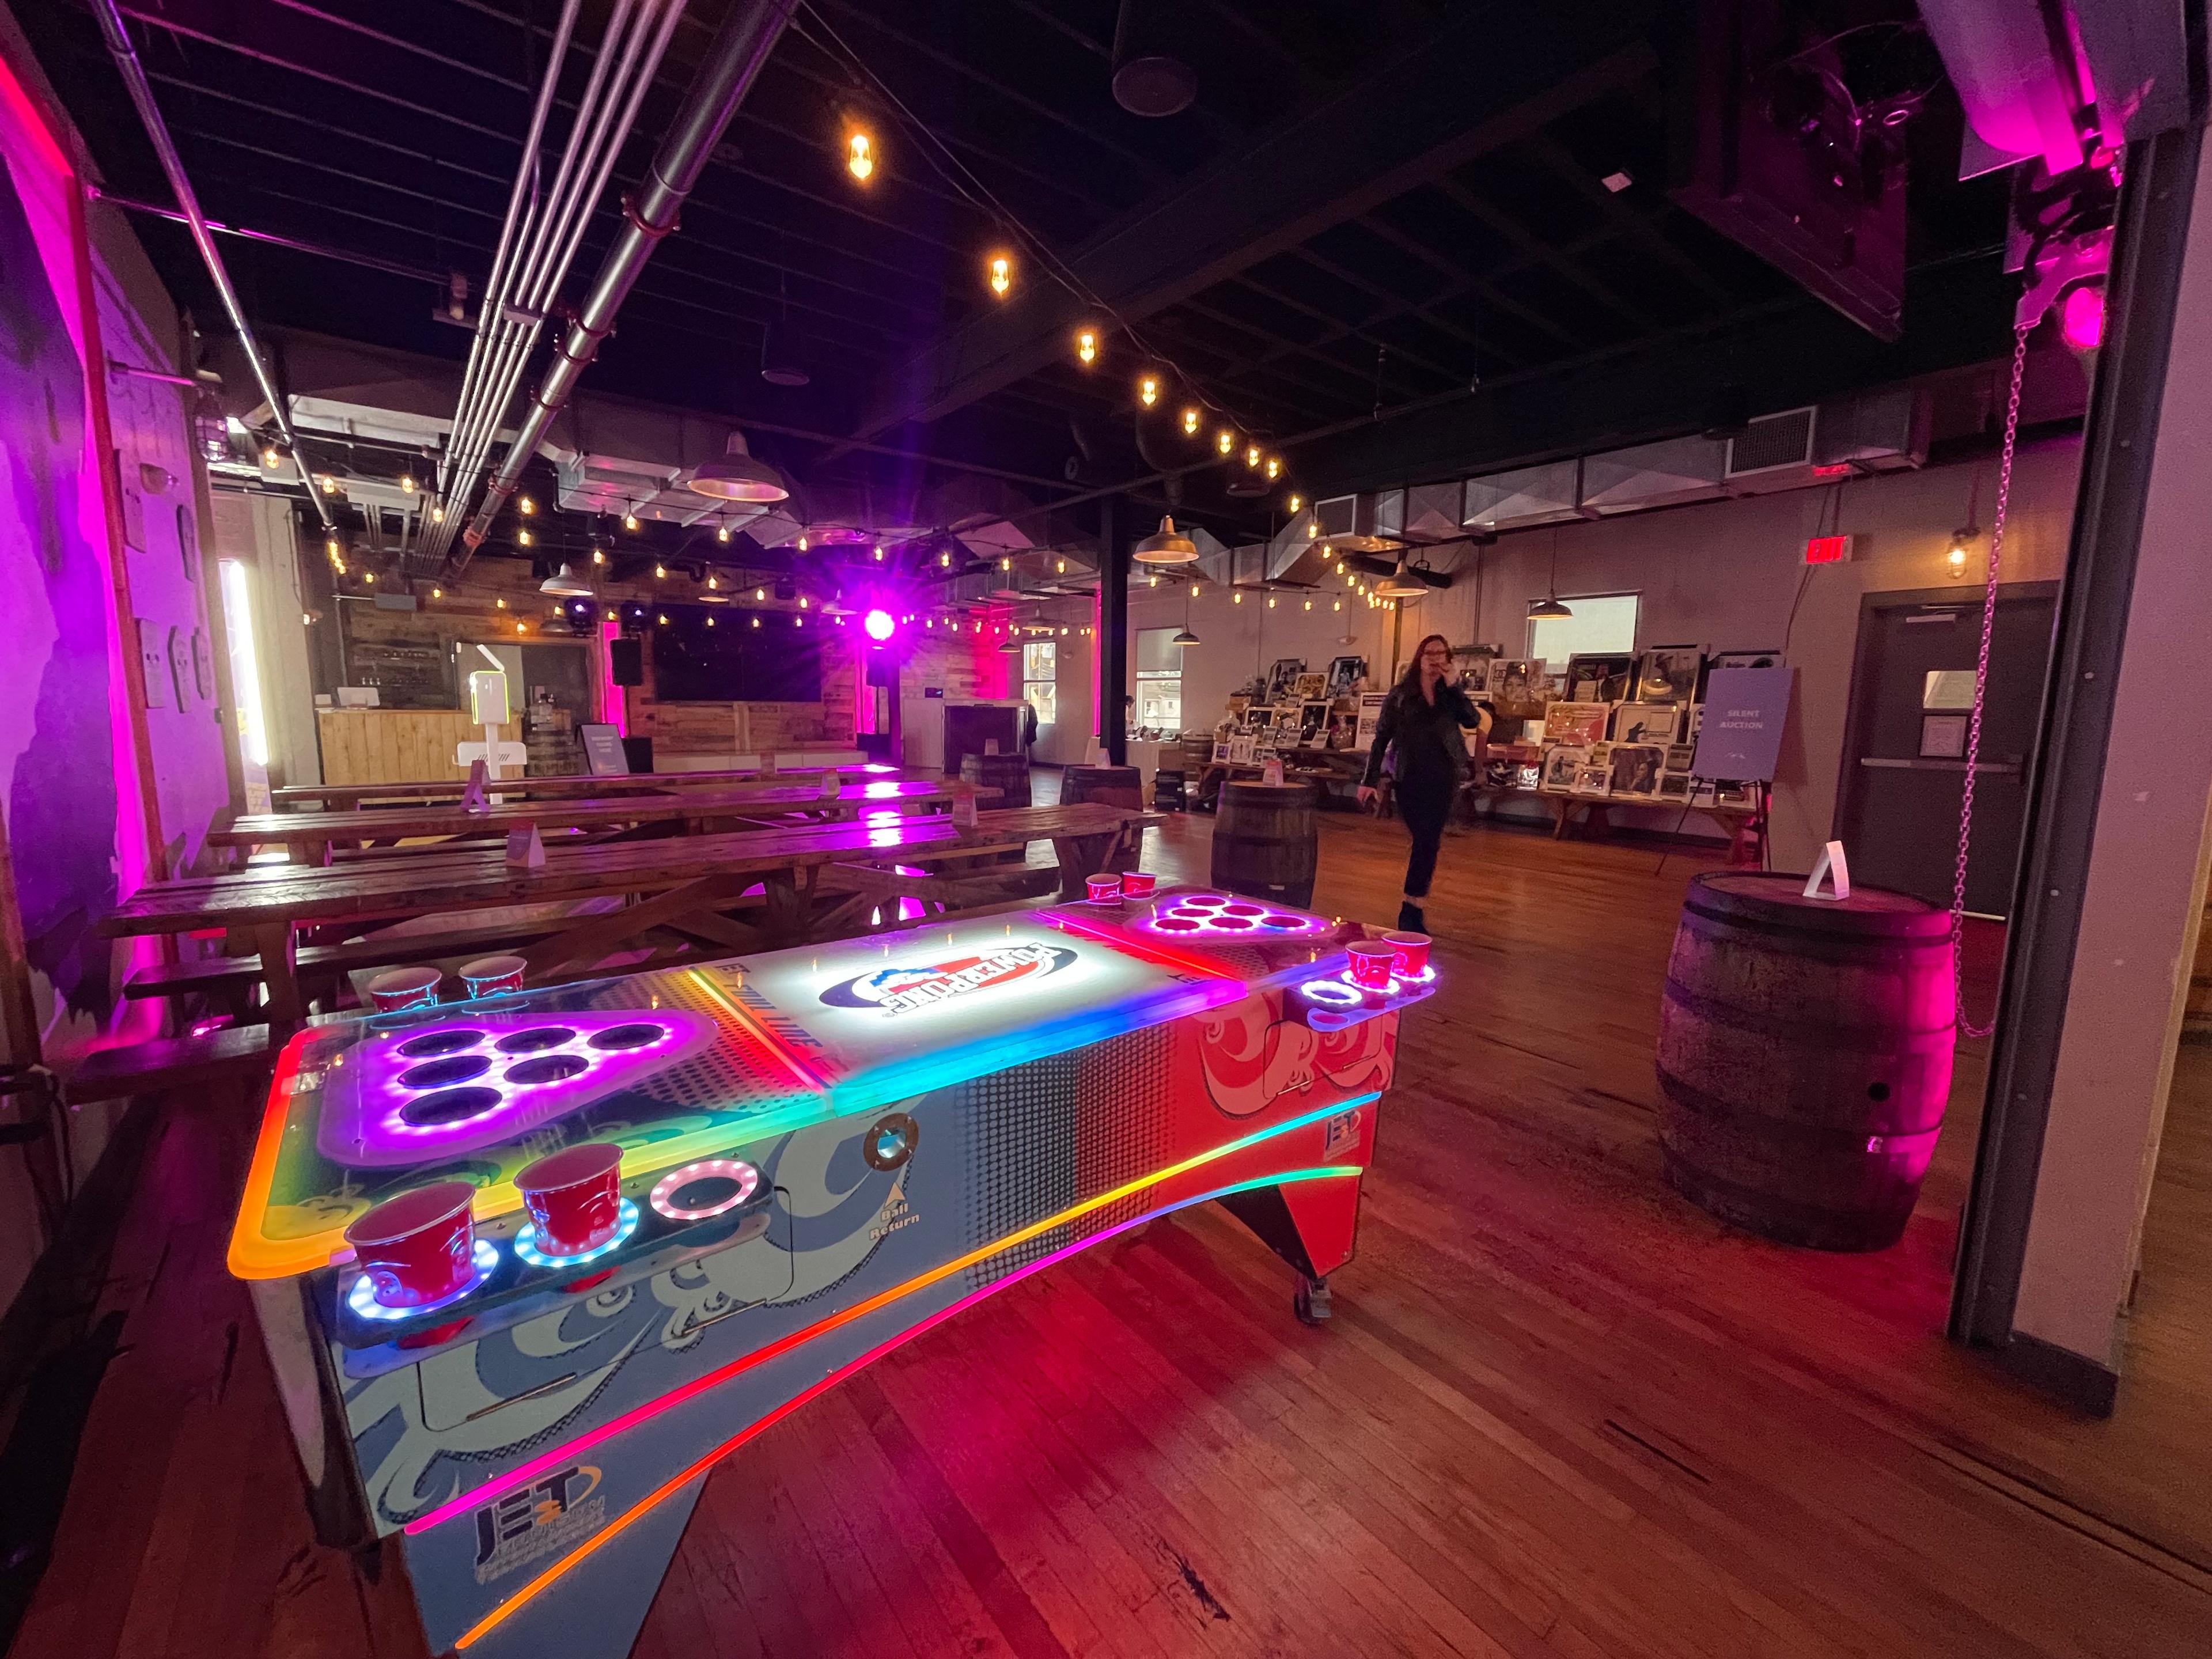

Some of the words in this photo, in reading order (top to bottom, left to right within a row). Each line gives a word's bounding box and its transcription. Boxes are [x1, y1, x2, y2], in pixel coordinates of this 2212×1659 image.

[1727, 709, 1760, 717] SILENT
[761, 1016, 823, 1047] LINE
[881, 1203, 908, 1222] Ball
[869, 1214, 920, 1240] Return
[476, 1465, 581, 1567] JET
